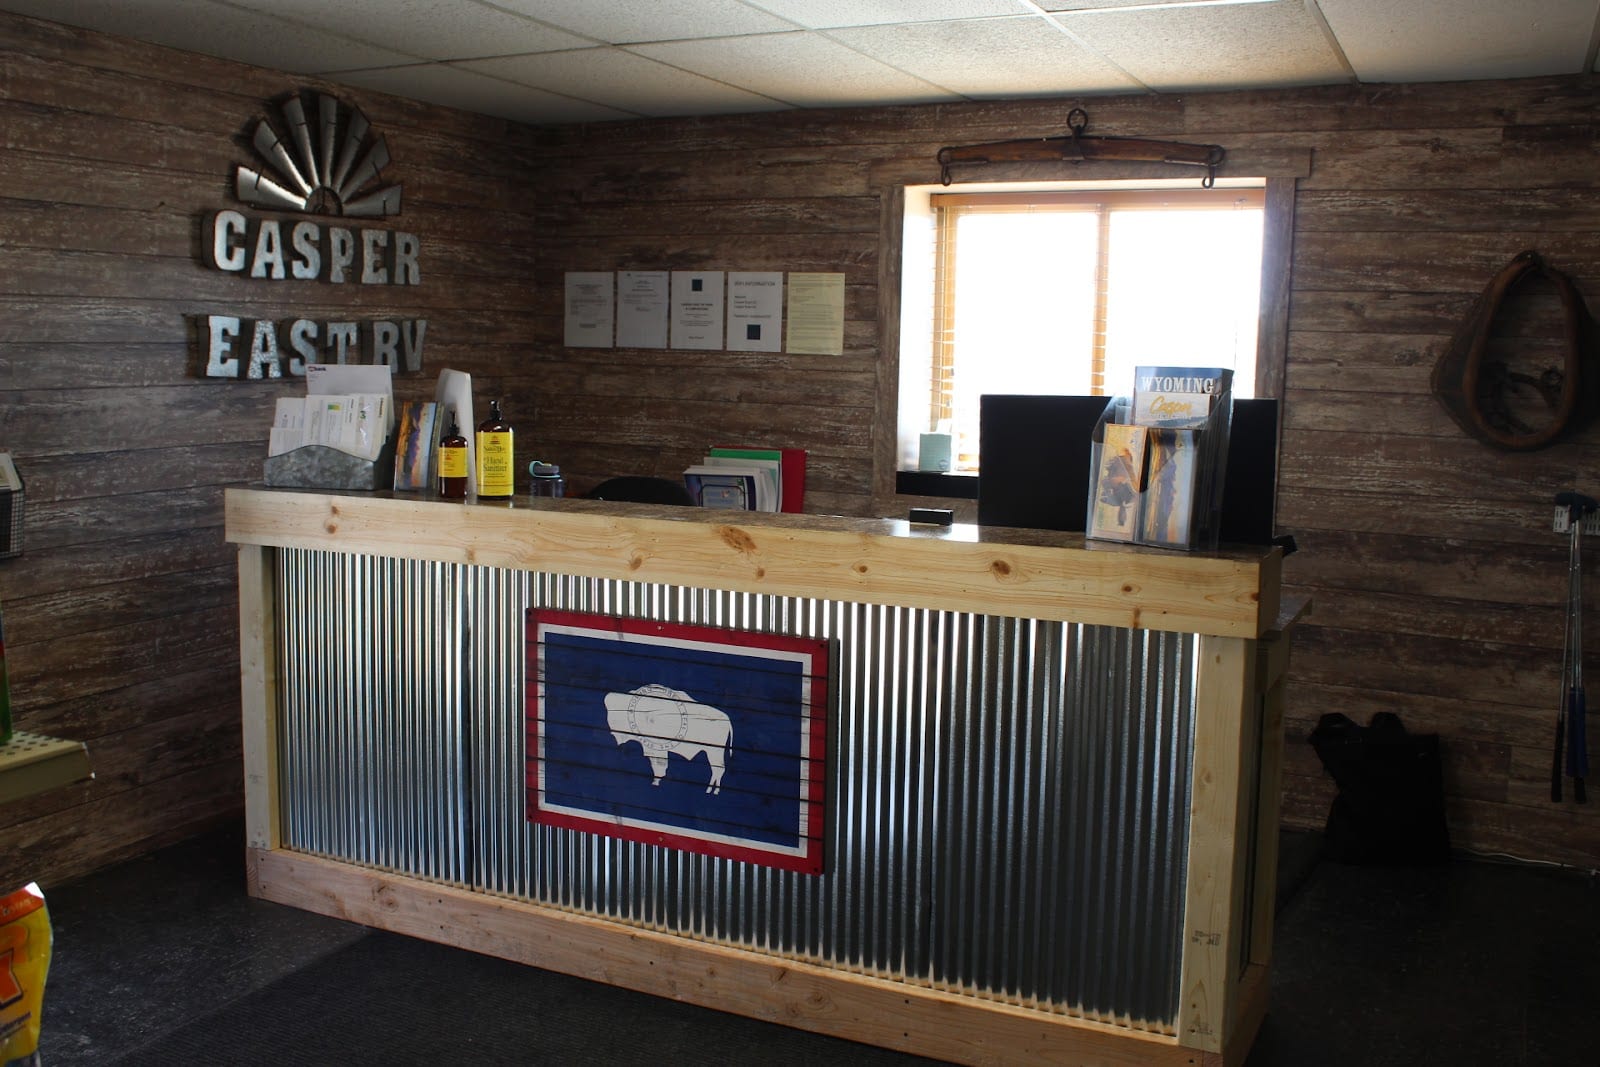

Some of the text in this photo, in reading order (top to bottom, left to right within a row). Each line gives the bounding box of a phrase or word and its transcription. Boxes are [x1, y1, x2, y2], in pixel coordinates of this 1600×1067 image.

[213, 209, 422, 285] CASPER
[207, 315, 428, 378] EAST RV
[1141, 376, 1214, 393] WYOMING
